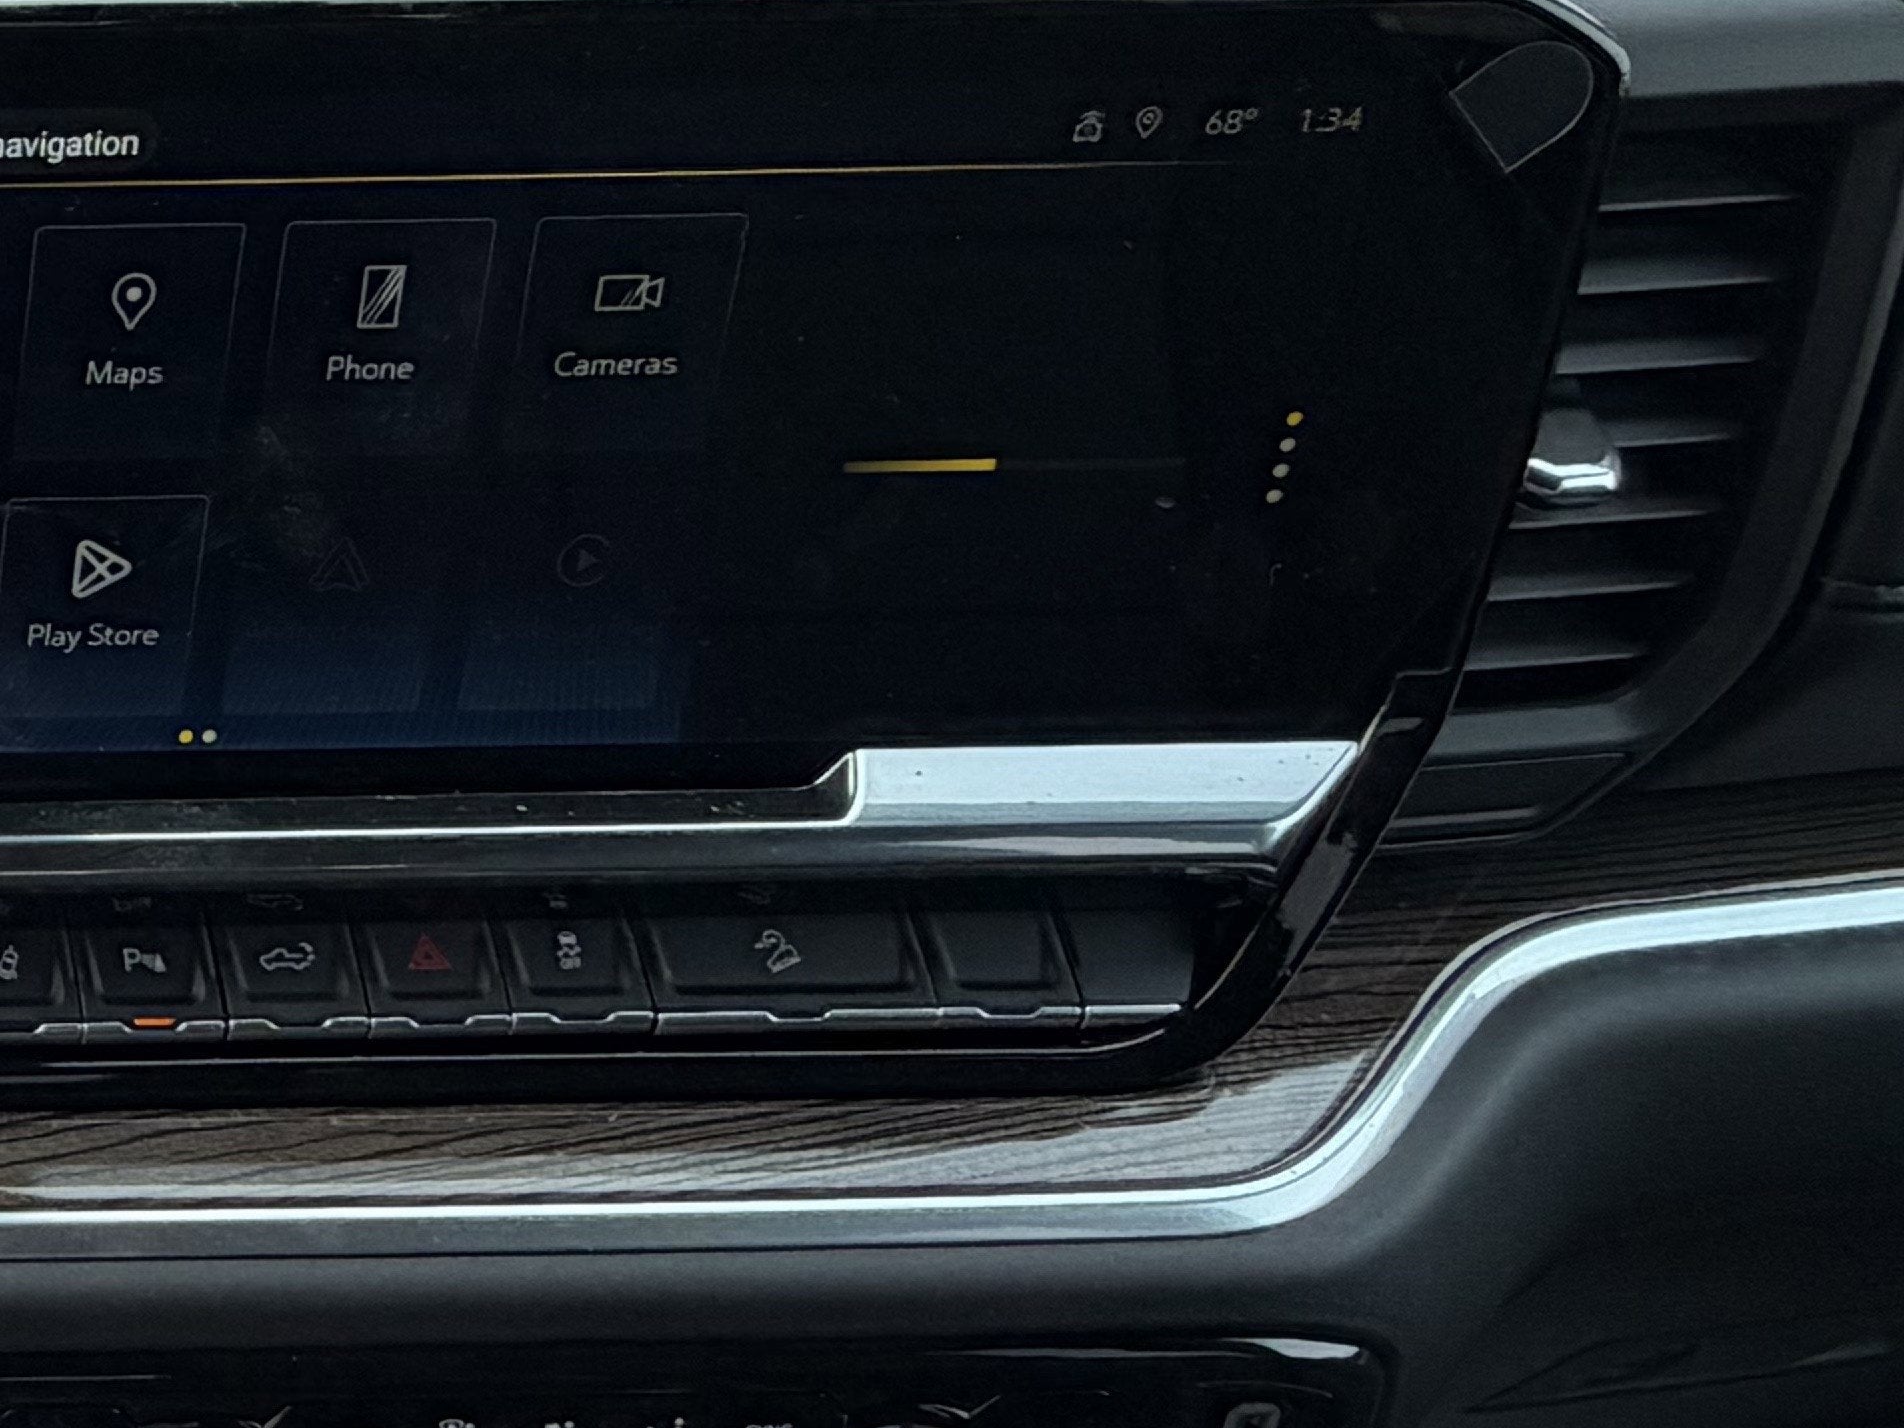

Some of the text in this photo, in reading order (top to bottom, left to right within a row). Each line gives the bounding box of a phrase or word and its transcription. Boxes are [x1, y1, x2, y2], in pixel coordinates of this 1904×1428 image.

[85, 361, 163, 391] Maps
[326, 356, 414, 381] Phone
[554, 351, 678, 377] Cameras
[27, 622, 160, 653] Play Store
